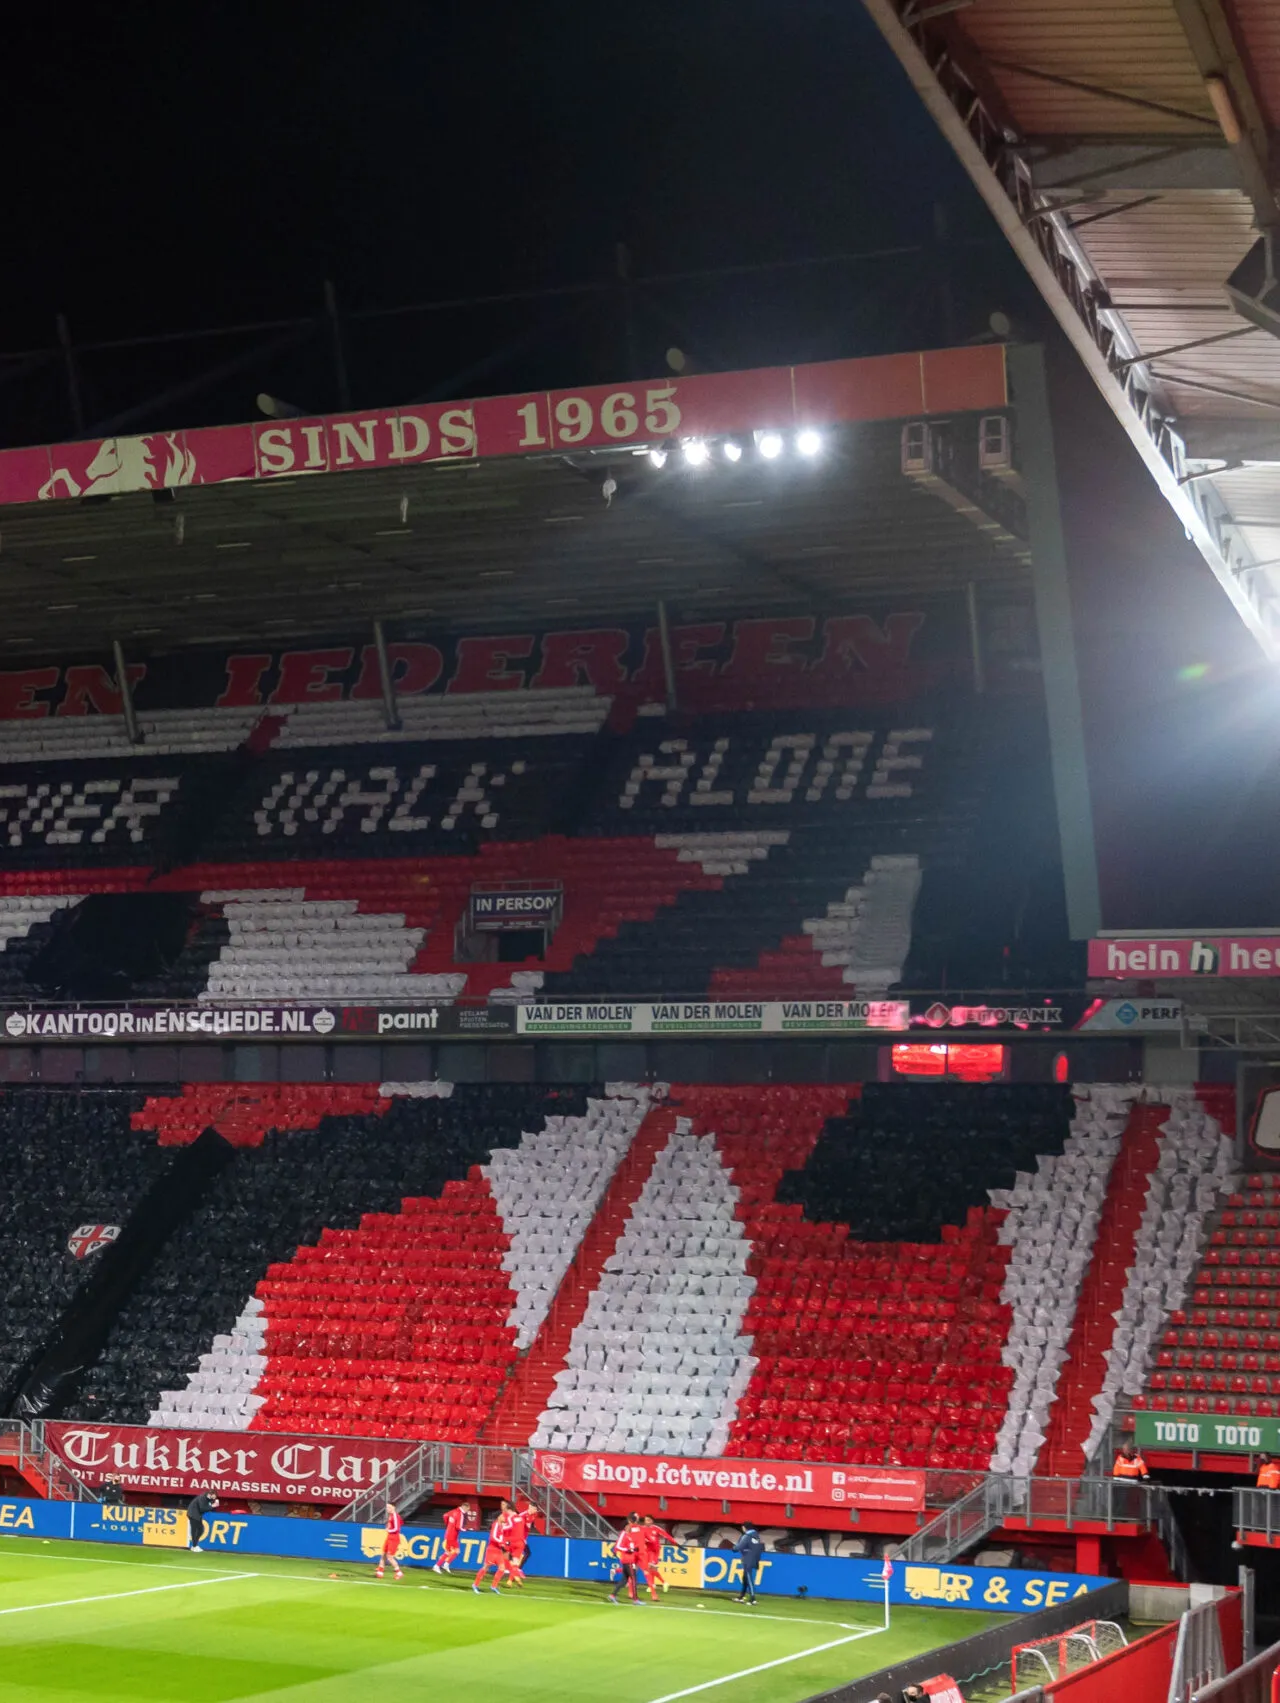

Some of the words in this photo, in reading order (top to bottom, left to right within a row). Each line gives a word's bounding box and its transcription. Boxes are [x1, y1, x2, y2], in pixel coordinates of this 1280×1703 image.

[258, 409, 475, 472] SINDS
[518, 387, 682, 446] 1965
[216, 614, 925, 706] IEDEREEN
[476, 898, 492, 911] IN
[496, 896, 557, 911] PERSON
[1108, 944, 1179, 971] hein
[378, 1008, 439, 1034] paint
[526, 1006, 552, 1020] VAN
[557, 1006, 582, 1020] DER
[586, 1006, 632, 1020] MOLEN
[651, 1005, 679, 1019] VAN
[684, 1005, 710, 1019] DER
[715, 1004, 762, 1018] MOLEN
[782, 1004, 811, 1018] VAN
[816, 1003, 843, 1017] DER
[61, 1430, 258, 1476] Tukker
[271, 1443, 400, 1484] Clan
[71, 1469, 95, 1480] DIT
[100, 1472, 113, 1483] IS
[119, 1473, 184, 1488] TWENTE!
[190, 1478, 280, 1494] AANPASSEN
[286, 1484, 306, 1495] OF
[583, 1459, 814, 1493] shop.fctwente.nl
[102, 1504, 177, 1525] KUIPERS
[102, 1523, 176, 1535] LOGISTICS
[983, 1576, 1012, 1604] &
